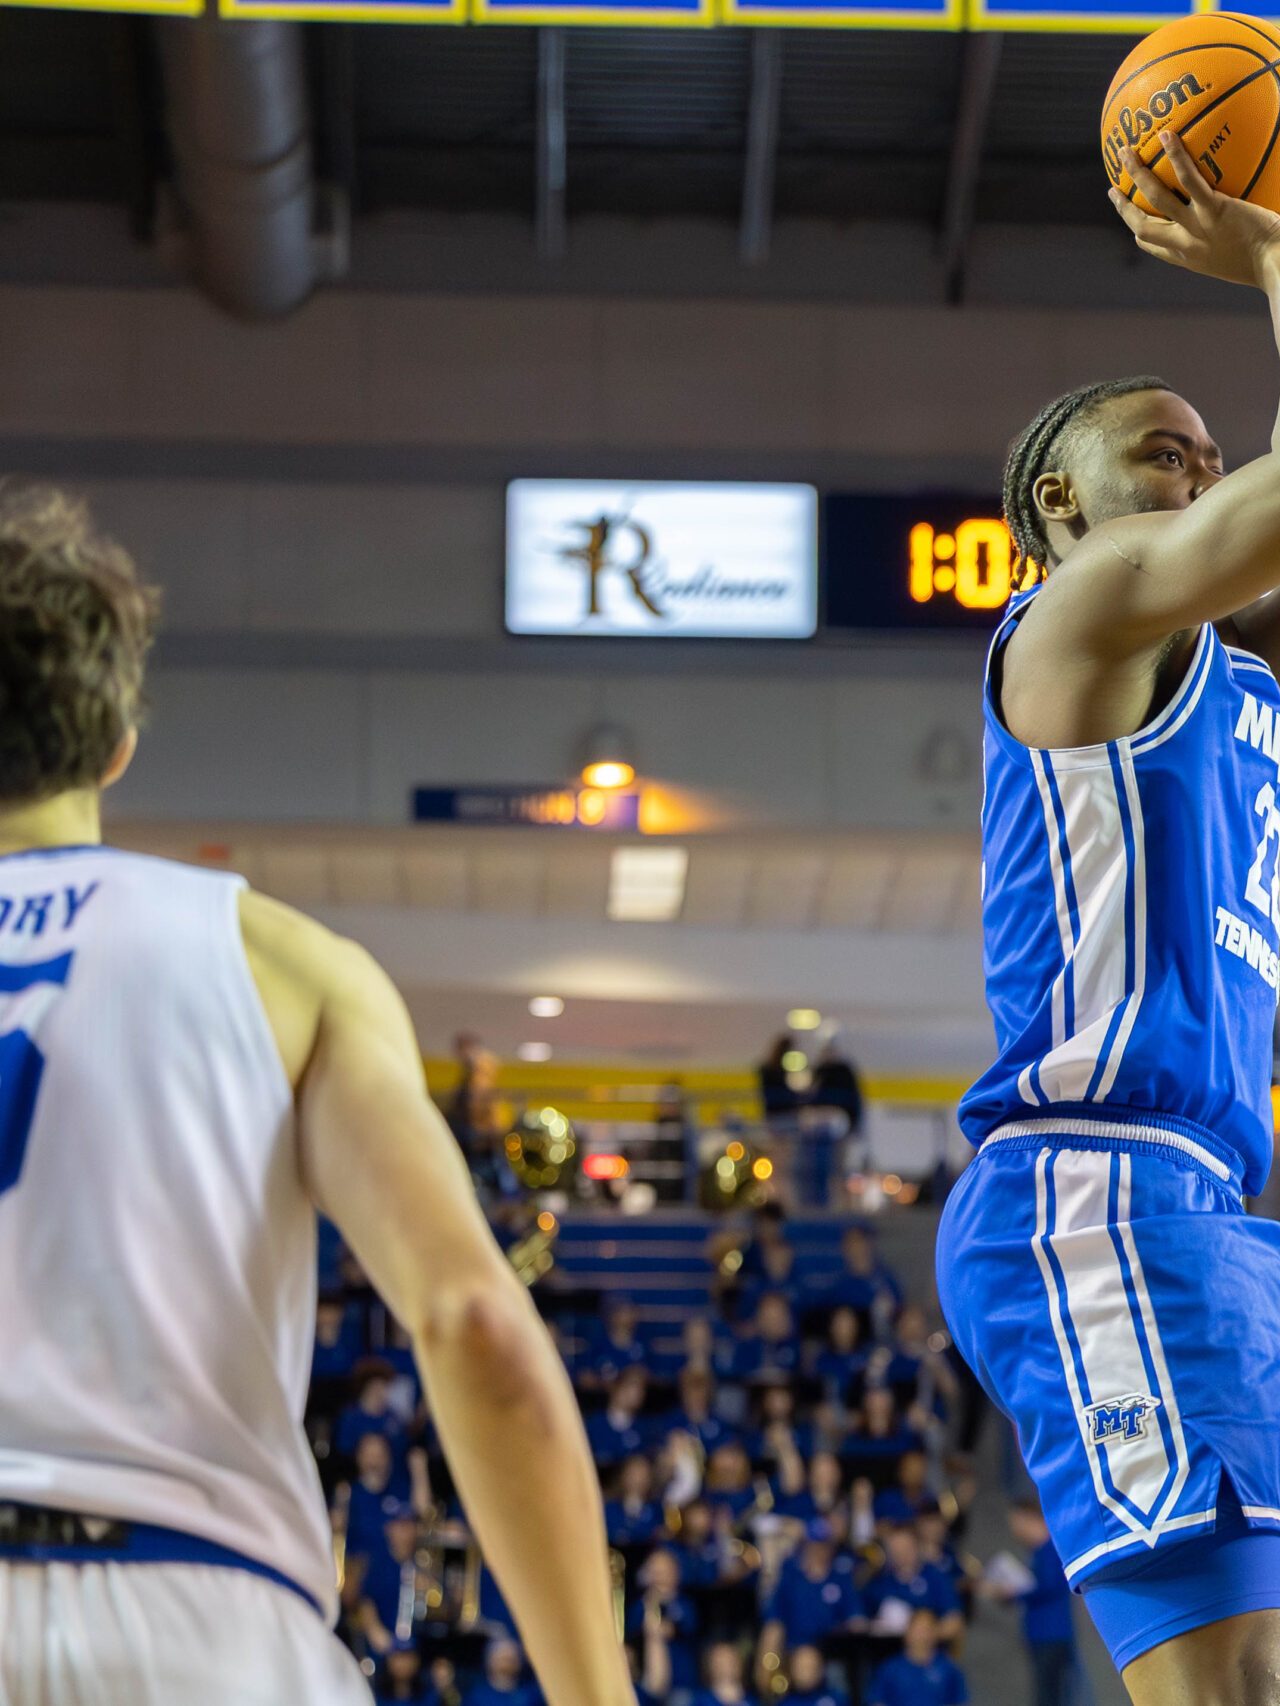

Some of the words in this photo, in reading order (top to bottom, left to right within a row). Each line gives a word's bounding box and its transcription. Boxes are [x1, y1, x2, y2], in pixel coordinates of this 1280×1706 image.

[1208, 121, 1233, 155] NXT
[910, 519, 1047, 609] 1:0
[1093, 1405, 1146, 1441] MT
